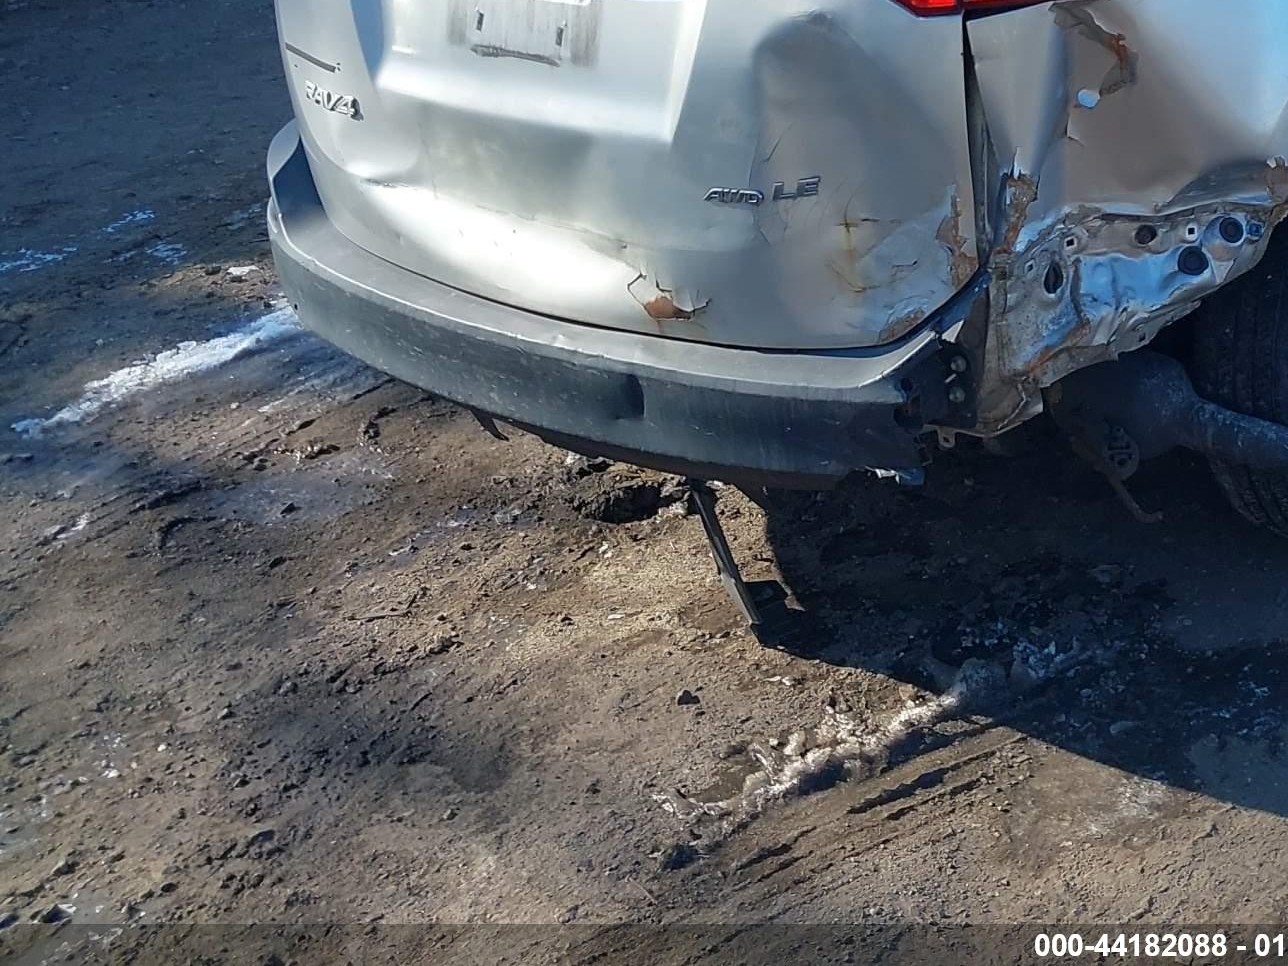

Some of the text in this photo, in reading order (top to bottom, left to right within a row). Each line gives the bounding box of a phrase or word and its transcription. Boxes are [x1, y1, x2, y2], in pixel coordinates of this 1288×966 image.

[304, 79, 358, 116] RAV4
[703, 176, 821, 204] AWD LE
